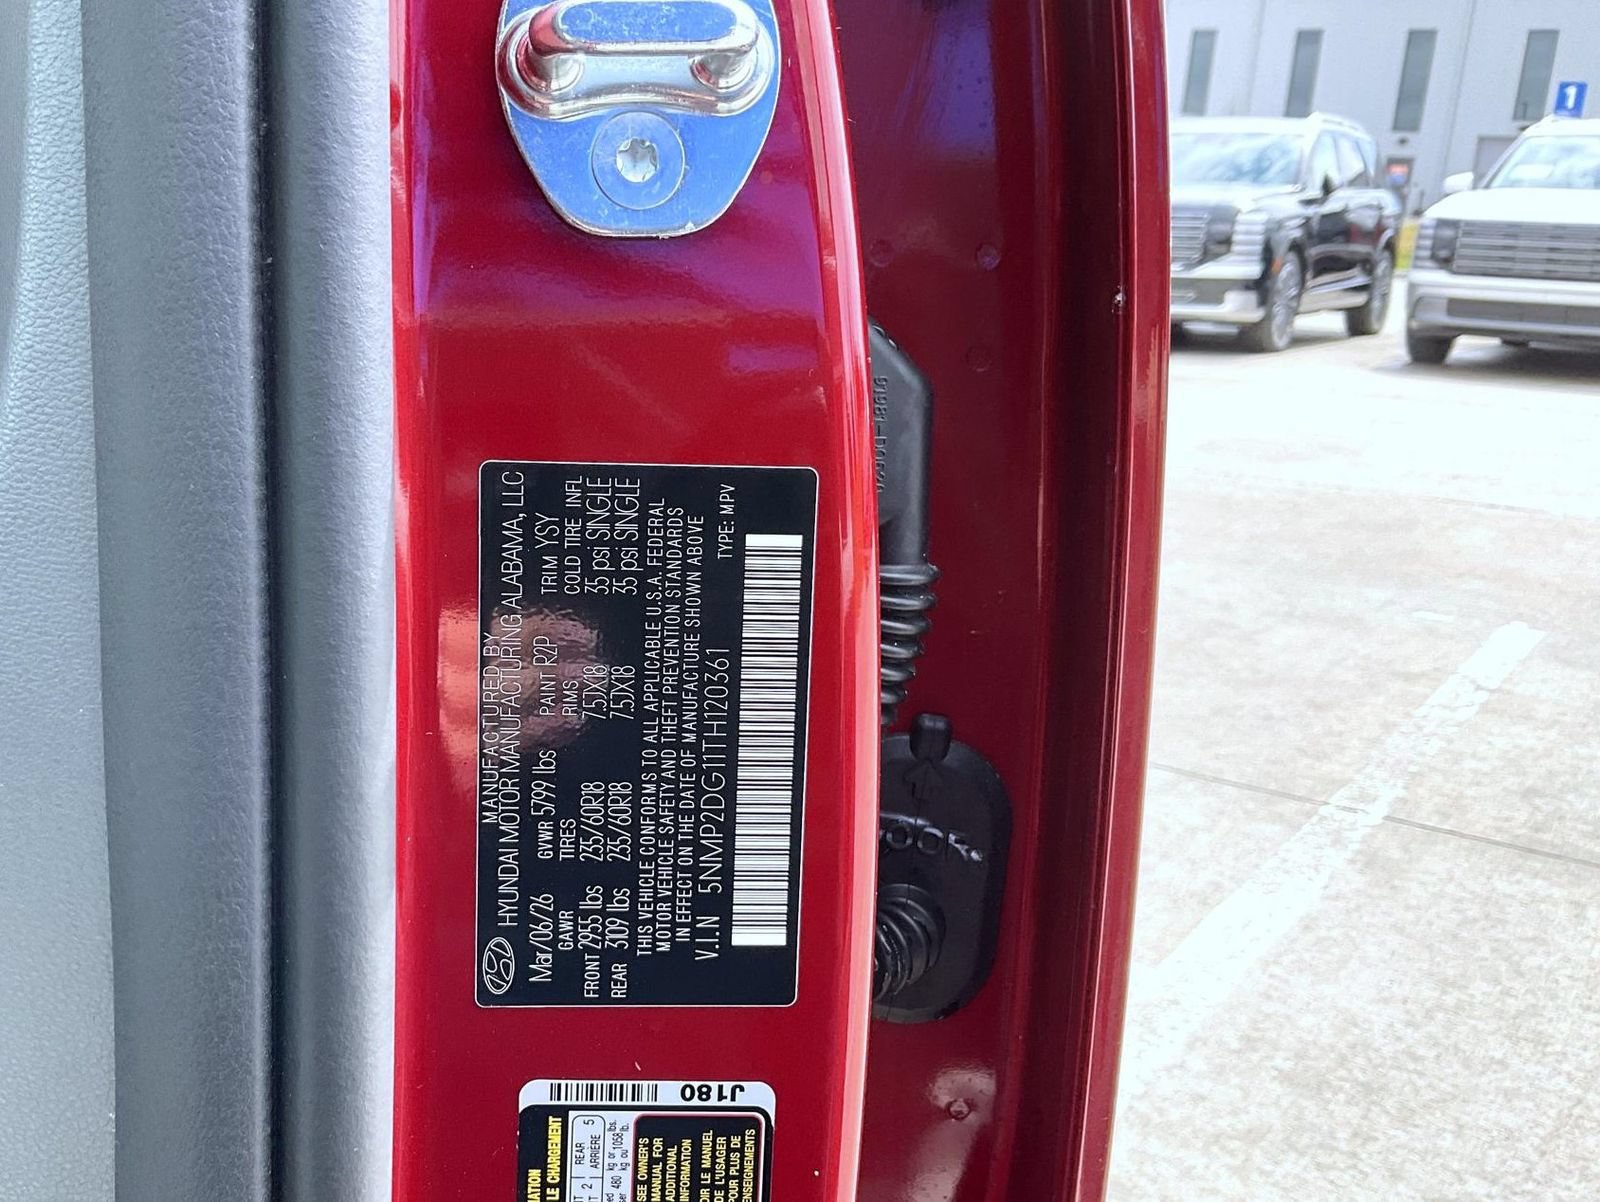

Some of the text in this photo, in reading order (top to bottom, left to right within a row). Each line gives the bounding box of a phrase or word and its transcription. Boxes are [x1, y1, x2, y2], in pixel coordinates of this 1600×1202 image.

[1563, 85, 1577, 110] 1
[535, 512, 559, 594] TRIM YSY
[565, 476, 582, 594] COLD TIRE INFL
[585, 478, 615, 595] 35 psi SINGLE
[612, 478, 643, 595] 35 psi SINGLE
[717, 484, 735, 559] TYPE: MPV
[498, 471, 526, 926] HYUNDAI MOTOR MANUFACTURING ALABAMA, LLC
[534, 636, 558, 716] PAINT R2P
[562, 680, 578, 716] RIMS
[582, 665, 608, 719] 7.5JX18
[609, 665, 635, 720] 7.5JX18
[483, 632, 500, 823] MANUFACTURED BY
[637, 498, 664, 956] THIS VEHICLE CONFORMS TO ALL APPLICABLE U.S.A. FEDERAL
[656, 507, 683, 951] MOTOR VEHICLE SAFETY AND THEFT PREVENTION STANDARDS
[675, 516, 704, 941] IN EFFECT ON THE DATE OF MANUFACTURE SHOWN ABOVE
[531, 750, 556, 858] GVWR 5799 lbs
[580, 782, 605, 862] 235/60R18
[607, 782, 632, 862] 235/60R18
[694, 648, 729, 960] V.I.N 5NMP2DG11TH120361
[560, 819, 576, 861] TIRES
[529, 894, 553, 982] Mar/06/26
[559, 911, 574, 950] GAWR
[578, 885, 602, 998] FRONT 2955 lbs
[605, 888, 630, 998] REAR 3109 lbs
[680, 1083, 745, 1102] J180
[546, 1116, 561, 1200] LE CHARGEMENT
[575, 1143, 585, 1165] REAR
[612, 1133, 623, 1149] 1058
[637, 1138, 649, 1201] SEE OWNER'S
[651, 1138, 663, 1201] MANUAL FOR
[666, 1145, 677, 1201] ADDITIONAL
[680, 1139, 691, 1201] INFORMATION
[701, 1130, 712, 1168] MANUEL
[714, 1137, 726, 1202] DE L'USAGER
[730, 1152, 740, 1175] PLUS
[731, 1136, 740, 1148] DE
[611, 1176, 621, 1189] 480
[701, 1172, 710, 1183] LE
